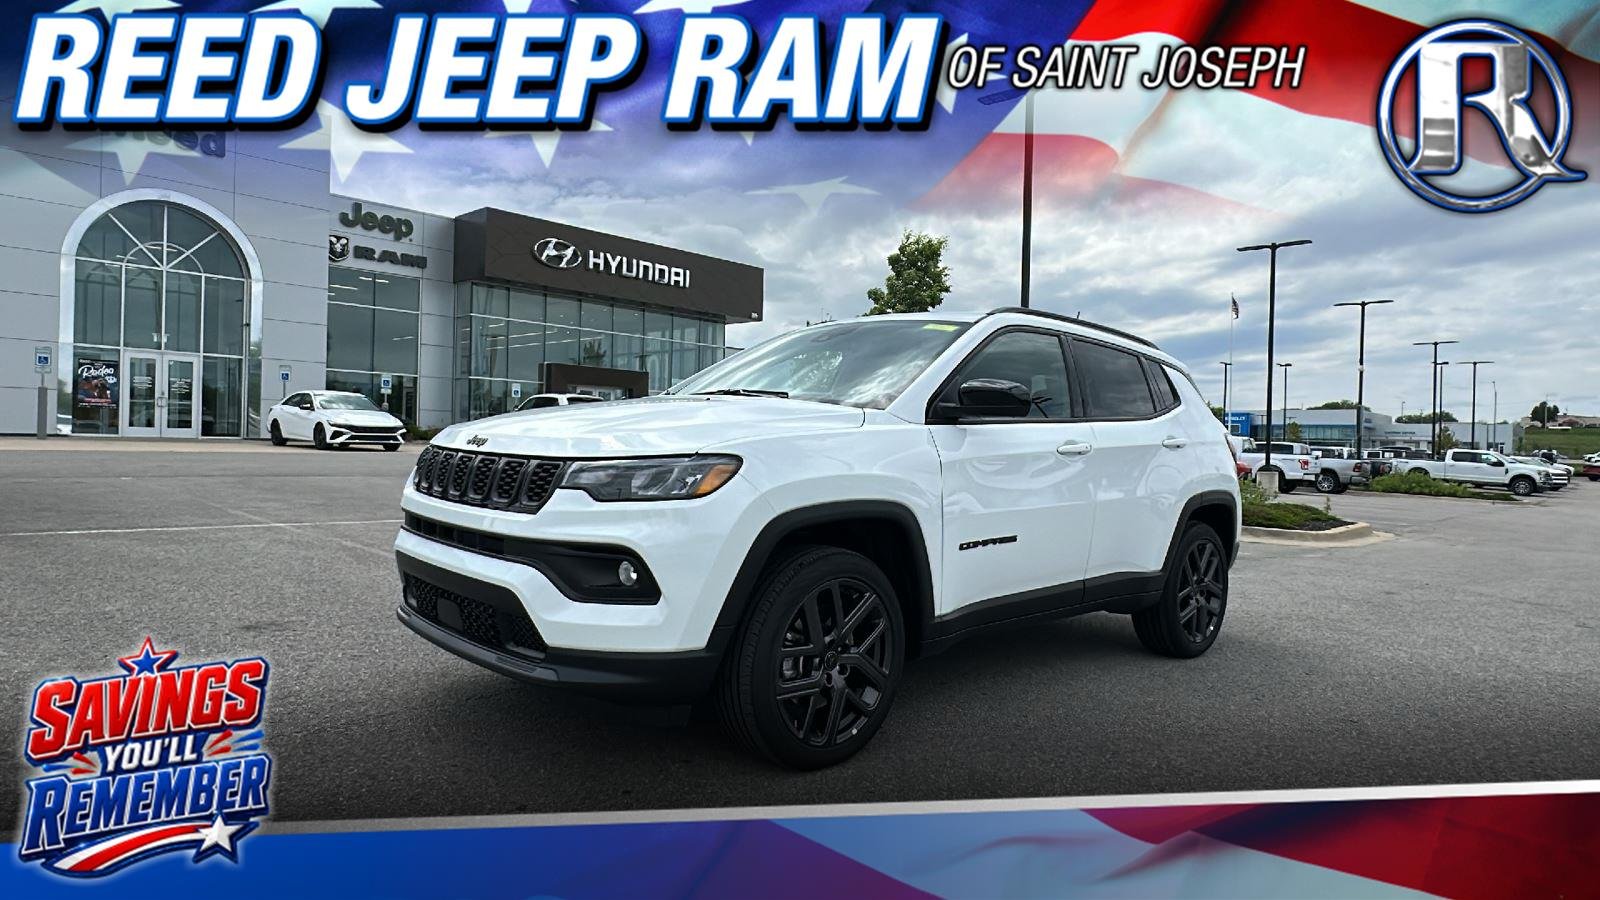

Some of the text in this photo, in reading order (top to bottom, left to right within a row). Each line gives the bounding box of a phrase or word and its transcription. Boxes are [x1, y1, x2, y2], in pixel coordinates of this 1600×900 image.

[338, 201, 414, 241] Jeep
[352, 245, 428, 270] RAM
[587, 249, 690, 289] HYUNDAI
[466, 434, 489, 448] Jeep
